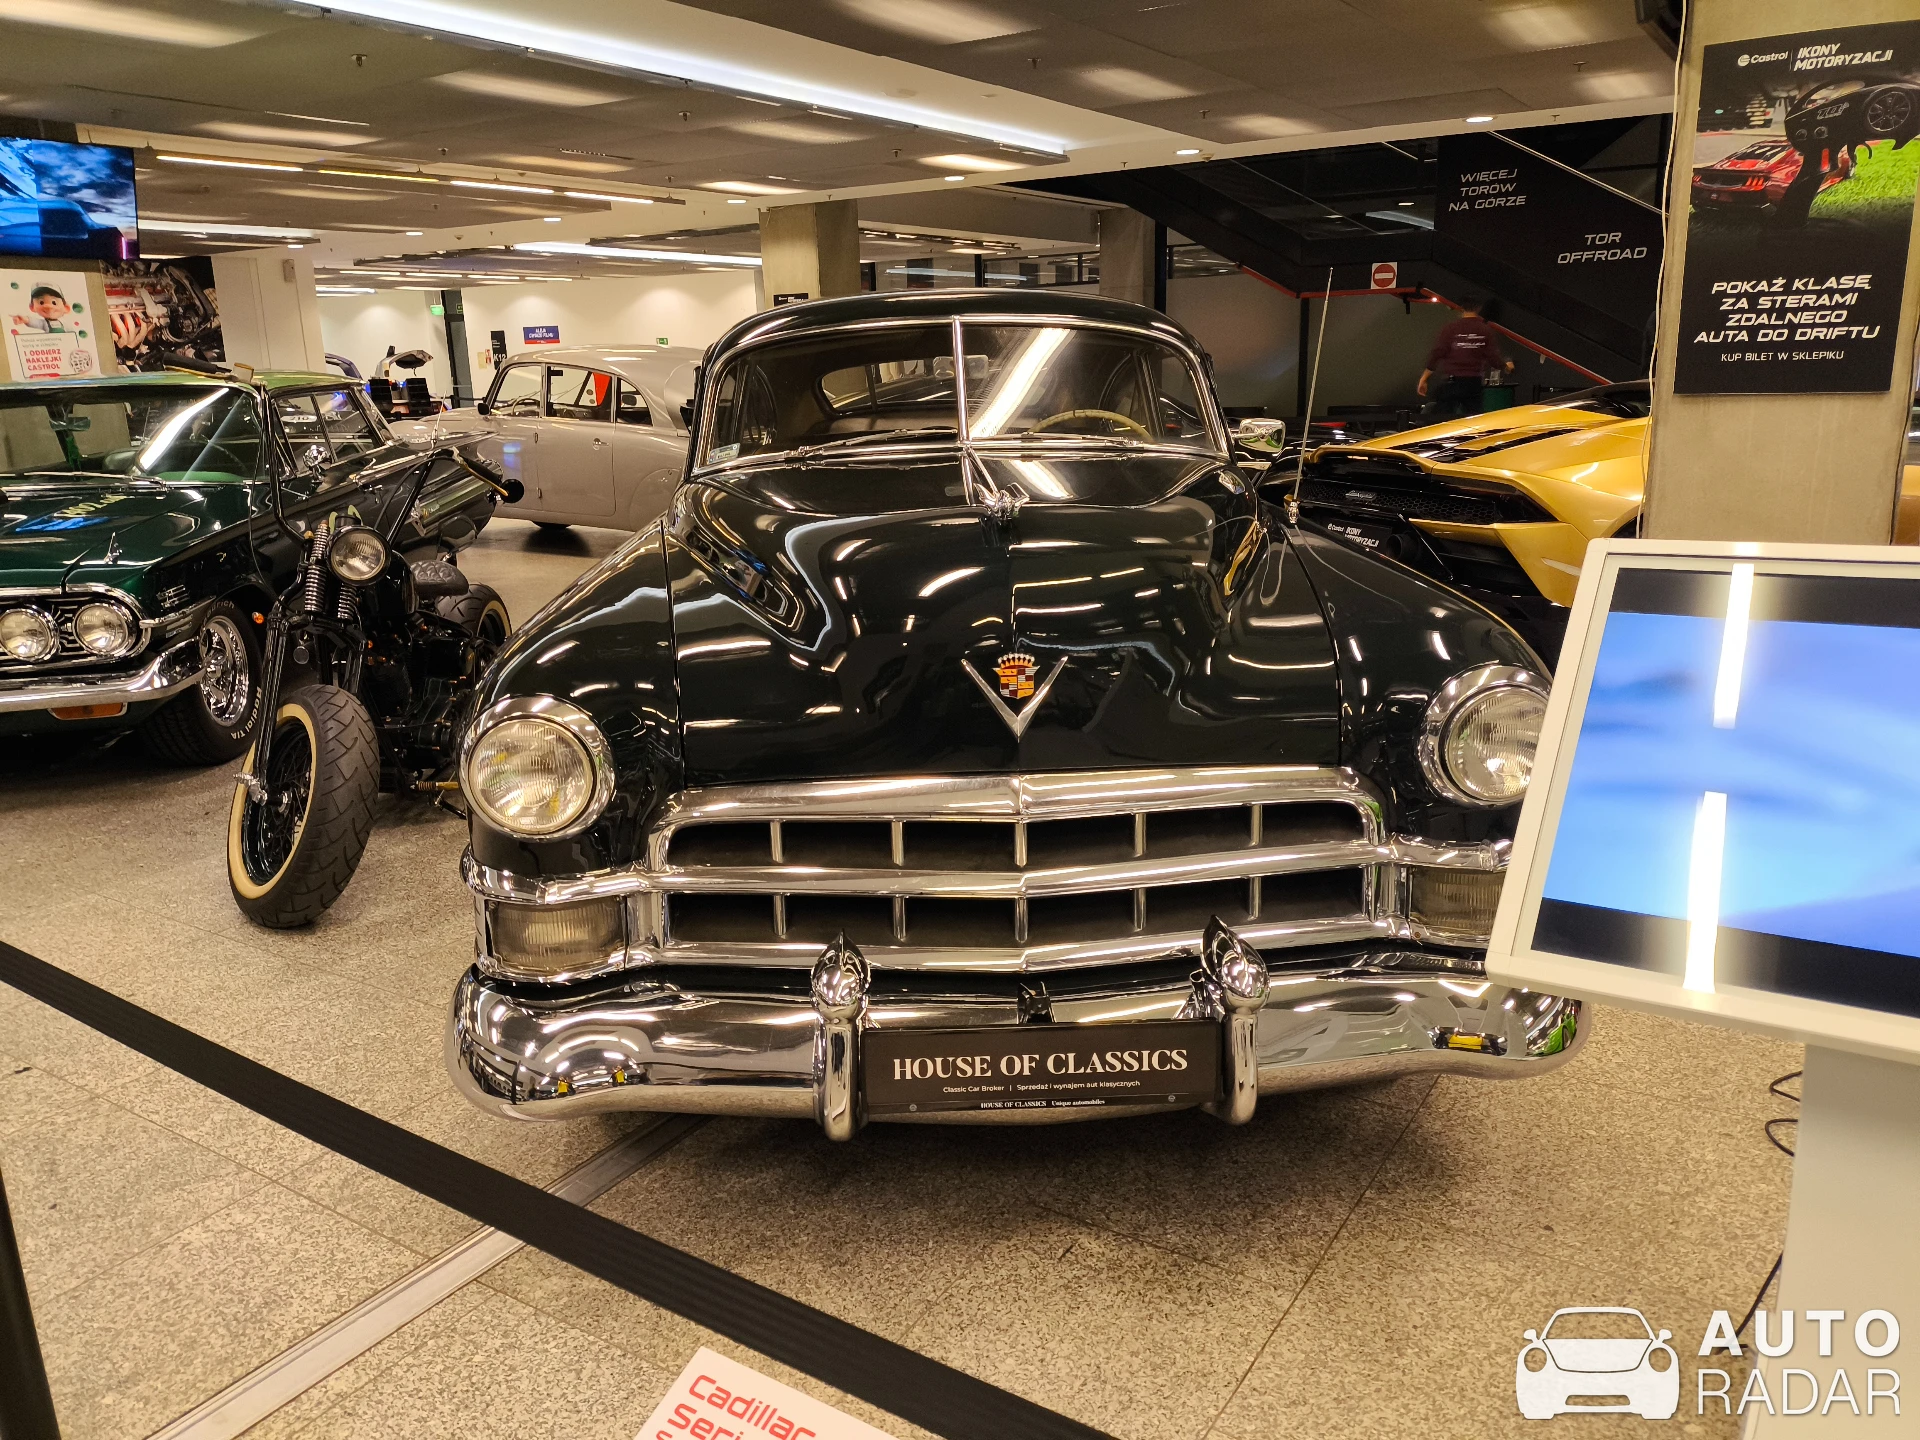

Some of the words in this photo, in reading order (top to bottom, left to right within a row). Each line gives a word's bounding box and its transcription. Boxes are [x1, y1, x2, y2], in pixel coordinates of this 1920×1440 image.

[1751, 51, 1788, 64] Castrol
[1797, 43, 1841, 59] IKONY
[1793, 50, 1893, 71] MOTORYZACJI
[1461, 169, 1517, 182] WIĘCEJ
[1460, 183, 1516, 196] TORÓW
[1449, 201, 1469, 211] NA
[1475, 196, 1526, 208] GÓRZE
[1585, 232, 1622, 245] TOR
[1557, 247, 1647, 263] OFFROAD
[1712, 277, 1786, 294] POKAŻ
[1792, 275, 1872, 290] KLASĘ
[1720, 297, 1748, 310] ZA
[1757, 292, 1858, 309] STERAMI
[1725, 310, 1848, 326] ZDALNEGO
[1693, 330, 1749, 343] AUTA
[1756, 329, 1789, 342] DO
[1794, 325, 1880, 341] DRIFTU
[30, 348, 61, 356] ODBIERZ
[1721, 353, 1742, 362] KUP
[1745, 352, 1773, 361] BILET
[1778, 352, 1789, 360] W
[1792, 350, 1844, 360] SKLEPIKU
[26, 356, 62, 364] NAKLEJKI
[245, 686, 262, 733] Radial
[893, 1055, 992, 1080] HOUSE
[1000, 1054, 1040, 1076] OF
[1047, 1049, 1188, 1075] CLASSICS
[982, 1084, 1004, 1092] Broker
[1017, 1083, 1048, 1092] Sprzedaż
[1053, 1083, 1085, 1091] wynajem
[1100, 1080, 1140, 1090] klasycznych
[1014, 1100, 1047, 1108] CLASSICS
[689, 1374, 816, 1440] Cadillac
